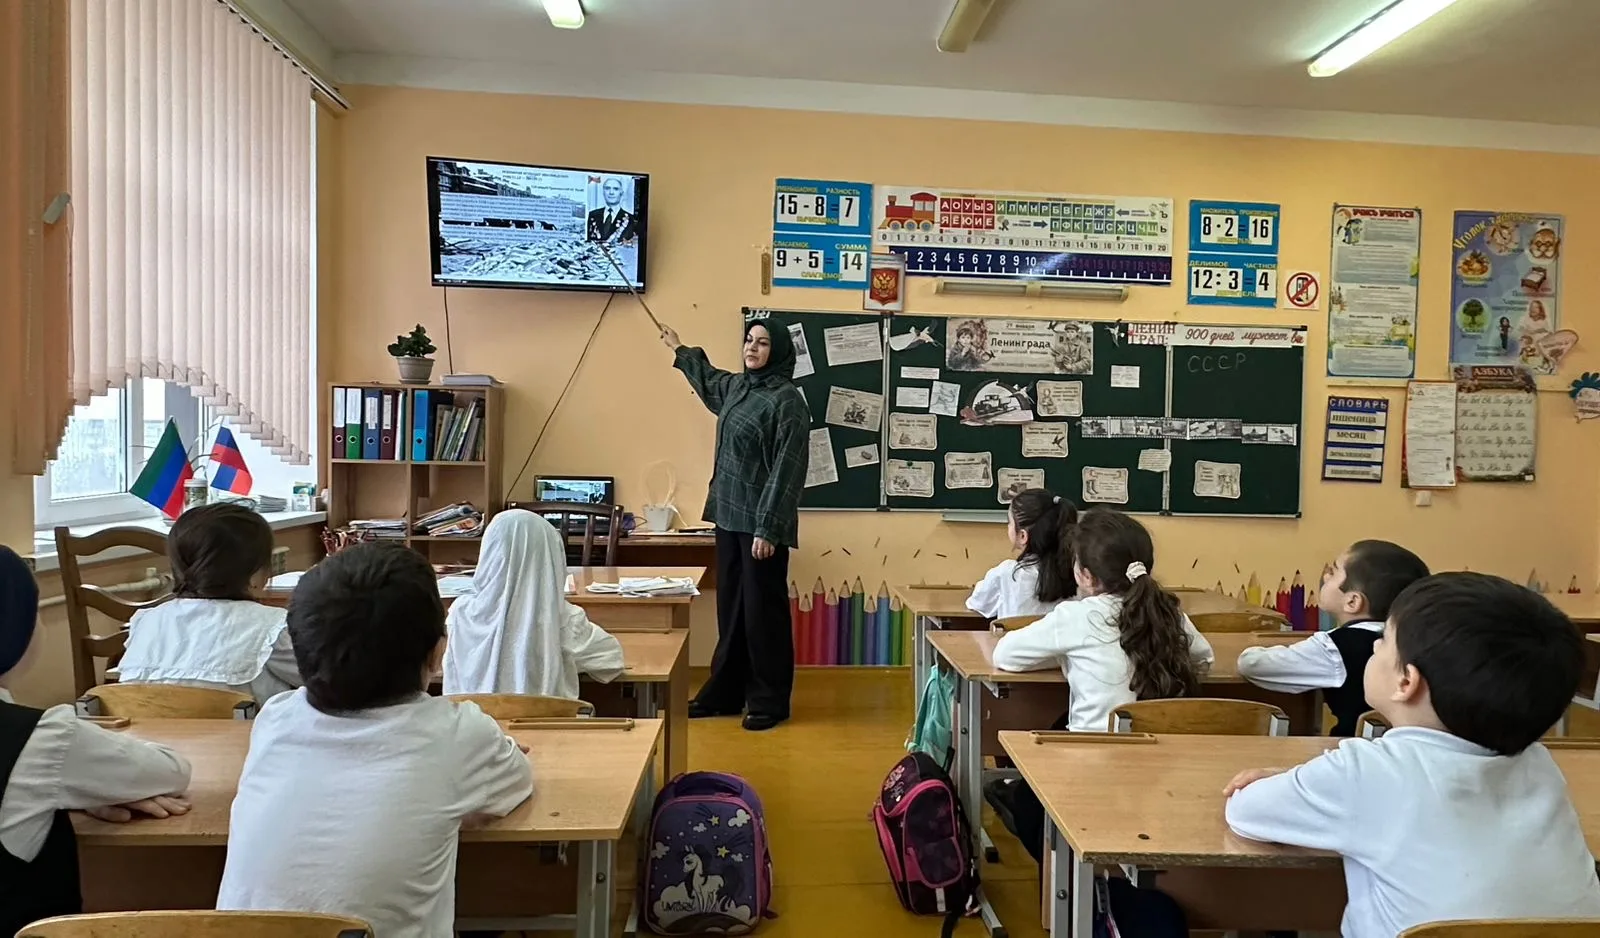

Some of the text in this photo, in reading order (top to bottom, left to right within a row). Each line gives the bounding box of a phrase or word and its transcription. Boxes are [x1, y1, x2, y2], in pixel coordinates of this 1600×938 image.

[778, 194, 798, 215] 15
[815, 196, 824, 216] 8
[845, 198, 853, 218] 7
[941, 201, 950, 210] А
[952, 202, 960, 210] О
[964, 202, 972, 210] У
[974, 202, 984, 210] Ы
[986, 202, 994, 211] Э
[1008, 204, 1016, 212] Л
[1019, 204, 1027, 212] М
[1030, 204, 1038, 212] Н
[1042, 204, 1048, 213] Р
[1052, 204, 1060, 214] Б
[1063, 204, 1070, 214] В
[1074, 205, 1080, 214] Г
[1084, 206, 1093, 216] Д
[1094, 206, 1104, 215] Ж
[1107, 206, 1113, 215] З
[941, 218, 949, 226] Я
[962, 217, 973, 226] Ю
[1052, 220, 1059, 229] П
[1062, 220, 1071, 230] Ф
[1074, 220, 1081, 230] К
[1085, 222, 1092, 230] Т
[1094, 222, 1104, 230] Ш
[1106, 222, 1113, 230] С
[1117, 222, 1124, 231] Х
[1128, 222, 1135, 232] Ц
[1202, 216, 1212, 236] 8
[1225, 218, 1234, 236] 2
[1252, 218, 1268, 238] 16
[776, 250, 786, 268] 9
[793, 256, 802, 264] +
[808, 251, 818, 268] 5
[842, 252, 862, 270] 14
[904, 251, 908, 261] 1
[918, 252, 924, 262] 2
[930, 252, 937, 262] 3
[944, 252, 951, 263] 4
[958, 253, 964, 264] 5
[972, 254, 978, 264] 6
[986, 254, 992, 264] 7
[1000, 254, 1006, 265] 8
[1014, 256, 1020, 266] 9
[1025, 256, 1037, 266] 10
[1194, 269, 1212, 288] 12
[1229, 270, 1238, 290] 3
[1258, 272, 1269, 291] 4
[1128, 324, 1176, 334] ЛЕНИН
[990, 337, 1051, 350] Ленинграда
[1184, 328, 1208, 340] 900
[1210, 331, 1234, 346] дней
[1187, 352, 1247, 373] СССР
[1473, 368, 1513, 376] АЗБУКА
[1330, 398, 1388, 410] СЛОВАРЬ
[1332, 414, 1376, 424] пшеница
[1336, 432, 1366, 440] месяц
